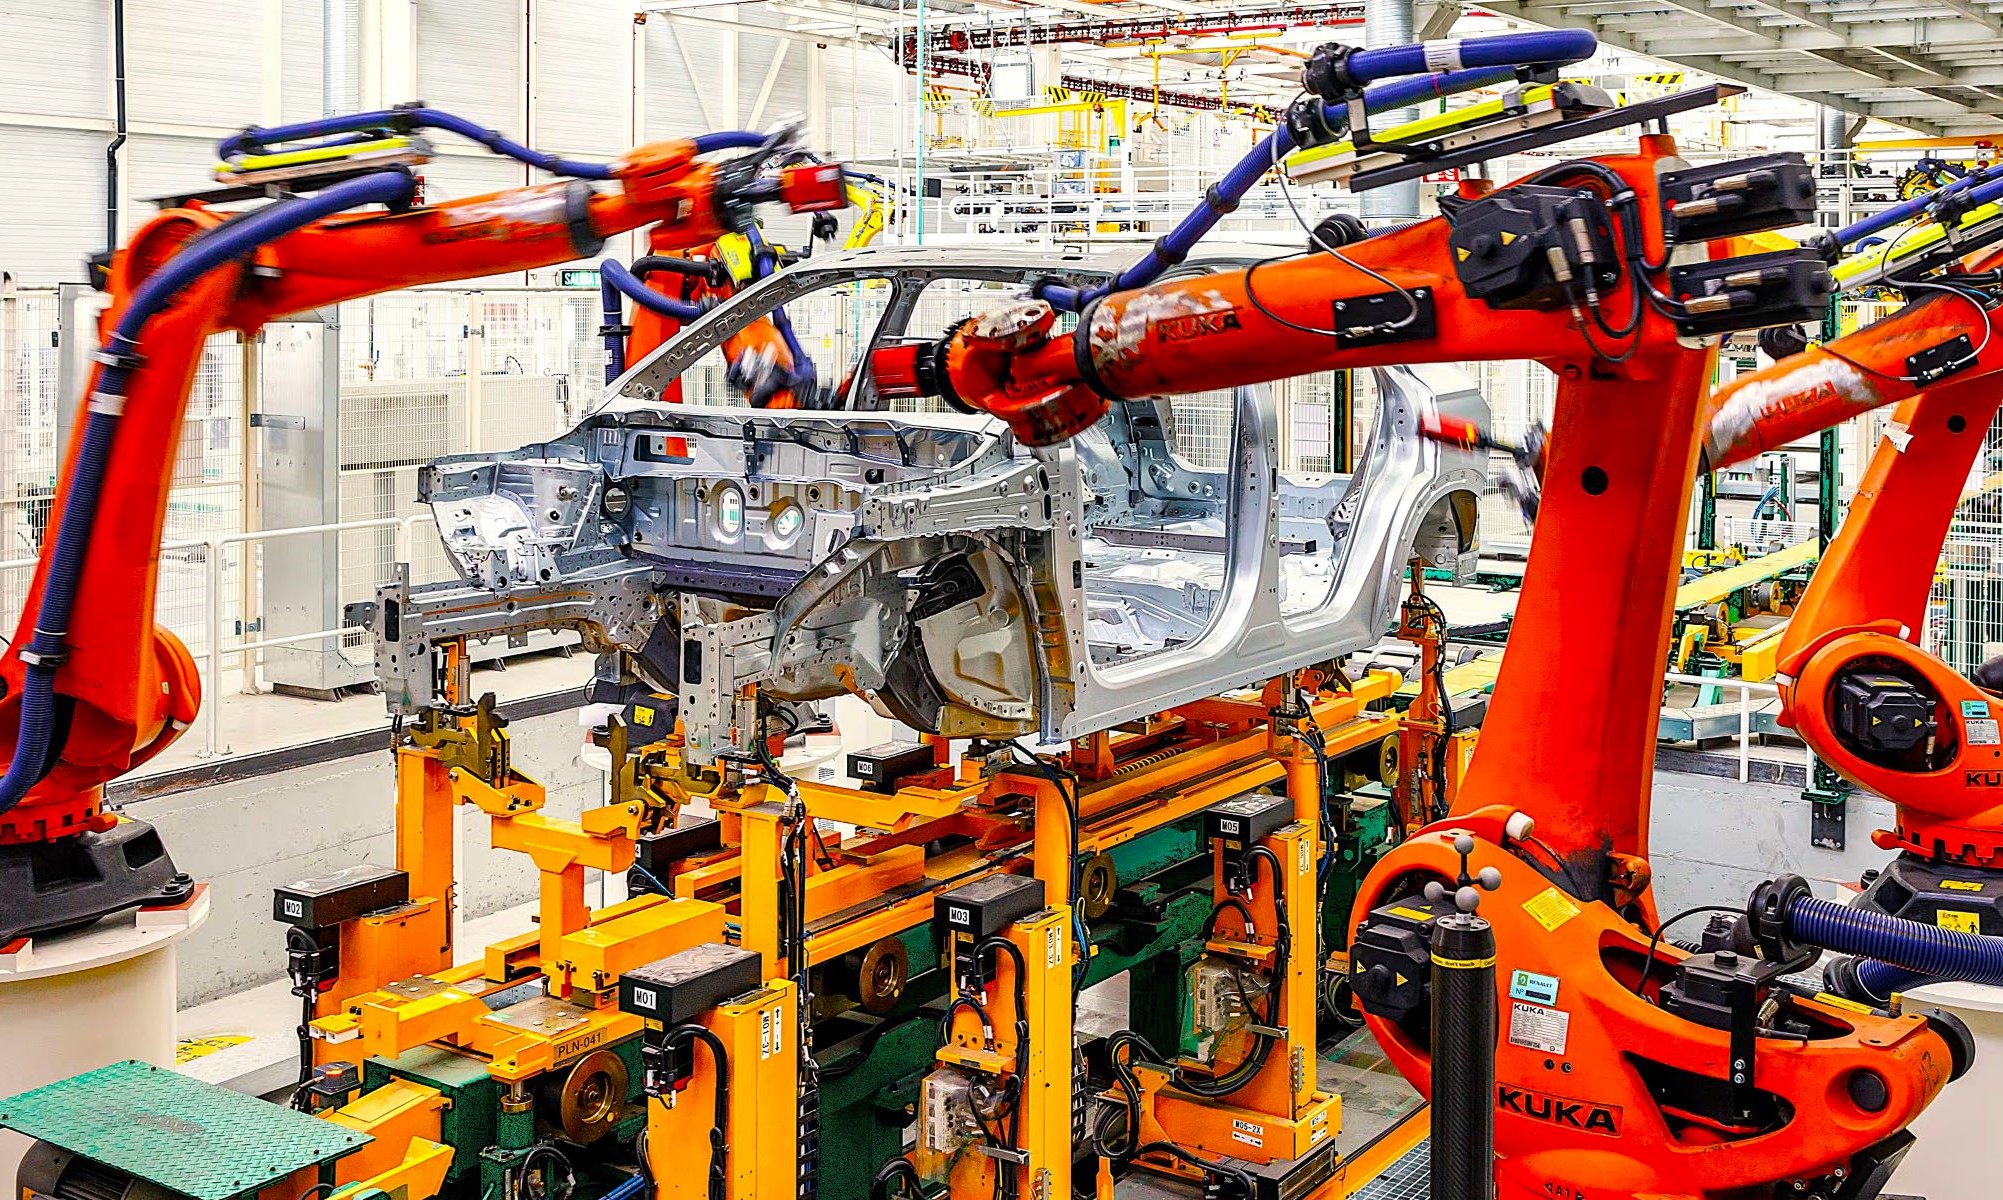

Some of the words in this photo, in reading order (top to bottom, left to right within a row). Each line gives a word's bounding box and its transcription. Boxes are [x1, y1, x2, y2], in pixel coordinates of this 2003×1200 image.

[1159, 310, 1243, 342] KUKA
[1221, 820, 1239, 832] M05
[286, 901, 301, 915] M02
[951, 909, 968, 922] M03
[1529, 979, 1553, 989] RENAULT
[636, 989, 653, 1007] M01
[1513, 1003, 1545, 1016] KUKA
[558, 1031, 602, 1058] PLN-041
[1498, 1086, 1618, 1133] KUKA
